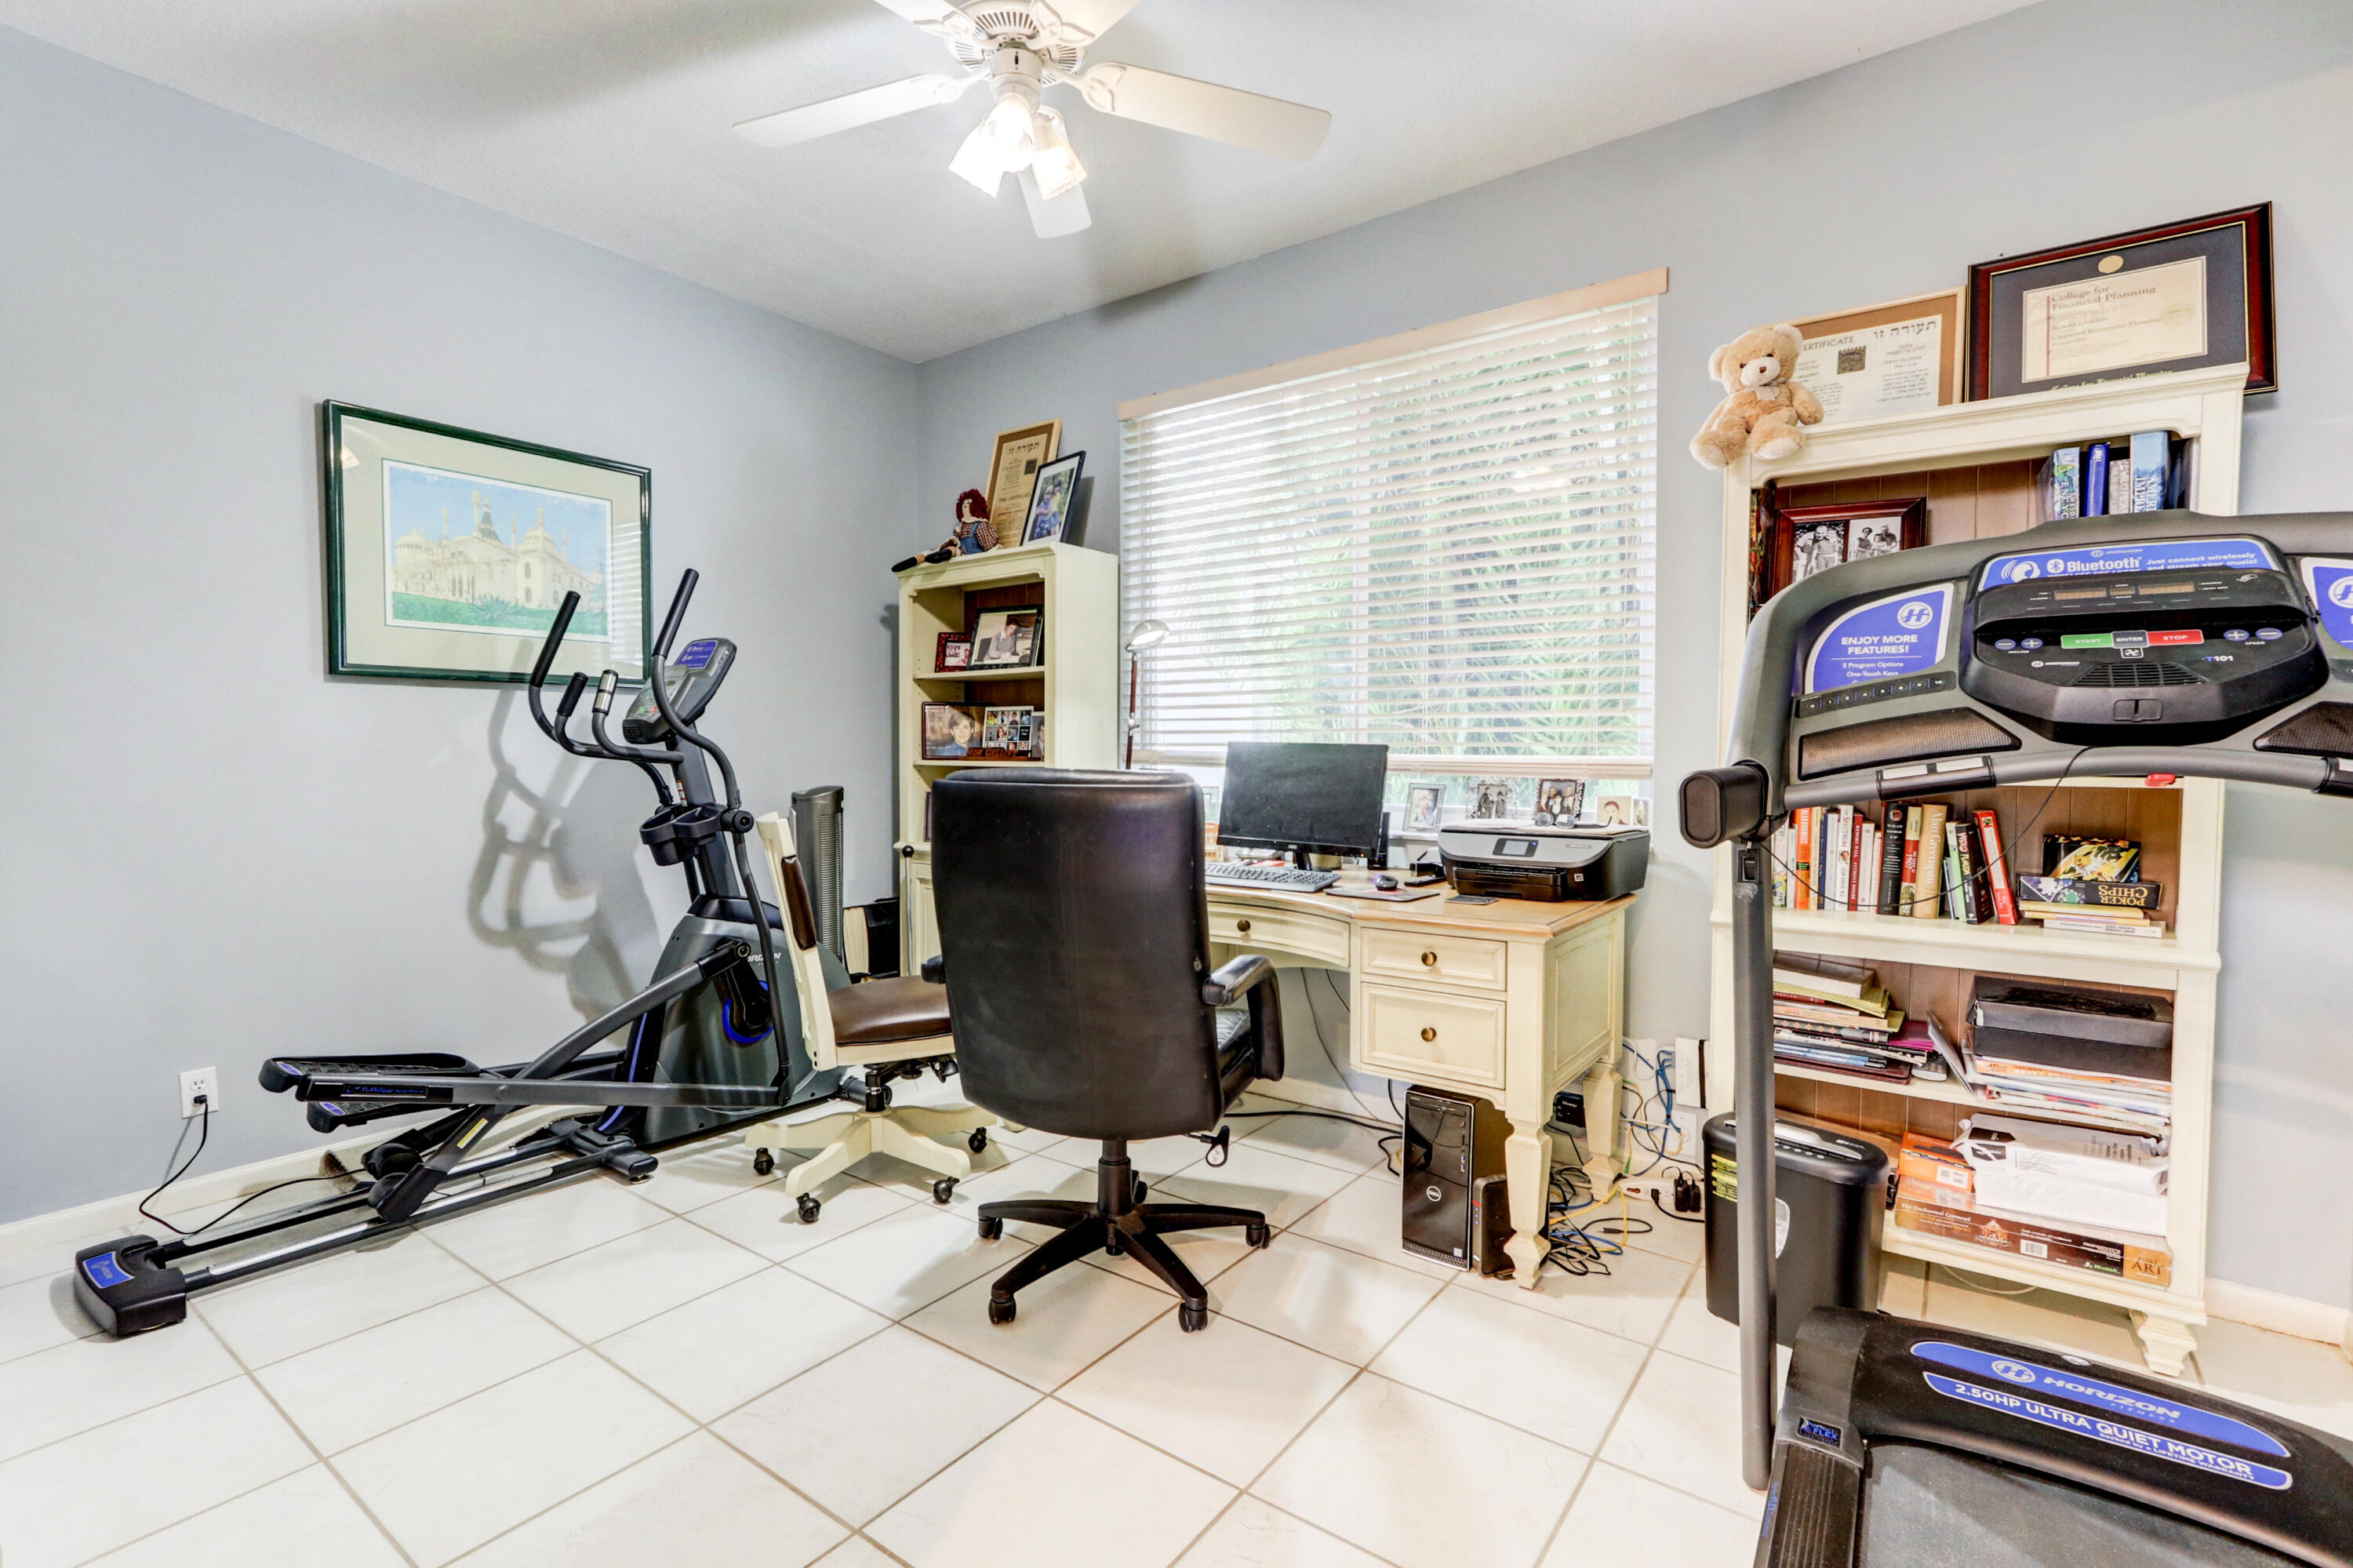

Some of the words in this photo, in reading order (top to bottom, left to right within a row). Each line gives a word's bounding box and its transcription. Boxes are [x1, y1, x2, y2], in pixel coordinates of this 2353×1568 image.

[2052, 289, 2091, 303] College
[2094, 286, 2111, 296] for
[2052, 295, 2100, 311] Financial
[2105, 286, 2156, 303] Planning
[1803, 336, 1854, 351] ERTIFICATE
[2060, 481, 2069, 518] ENCYC
[2134, 477, 2144, 512] IMPRE
[2147, 475, 2158, 512] AMERI
[2067, 557, 2140, 573] Bluetooth
[2167, 555, 2205, 565] connect
[2207, 552, 2255, 562] wirelessly
[1841, 636, 1880, 645] ENJOY
[1882, 635, 1918, 644] MORE
[1848, 645, 1910, 654] FEATURES!
[1932, 809, 1944, 832] Alan
[1923, 835, 1941, 884] Greenspan
[2098, 884, 2149, 898] CHIPS
[2100, 895, 2146, 907] POKER
[2043, 1376, 2181, 1419] HORIZON
[2111, 1402, 2176, 1424] FITNESS
[1813, 1427, 1839, 1440] FLEX
[1955, 1384, 2021, 1408] 2.50HP
[2025, 1402, 2093, 1429] ULTRA
[2096, 1422, 2162, 1449] QUIET
[2168, 1442, 2252, 1476] MOTOR
[2099, 1432, 2131, 1446] backed
[2133, 1440, 2143, 1450] by
[2153, 1445, 2196, 1464] LIFETIME
[2197, 1457, 2255, 1480] WARRANTY
